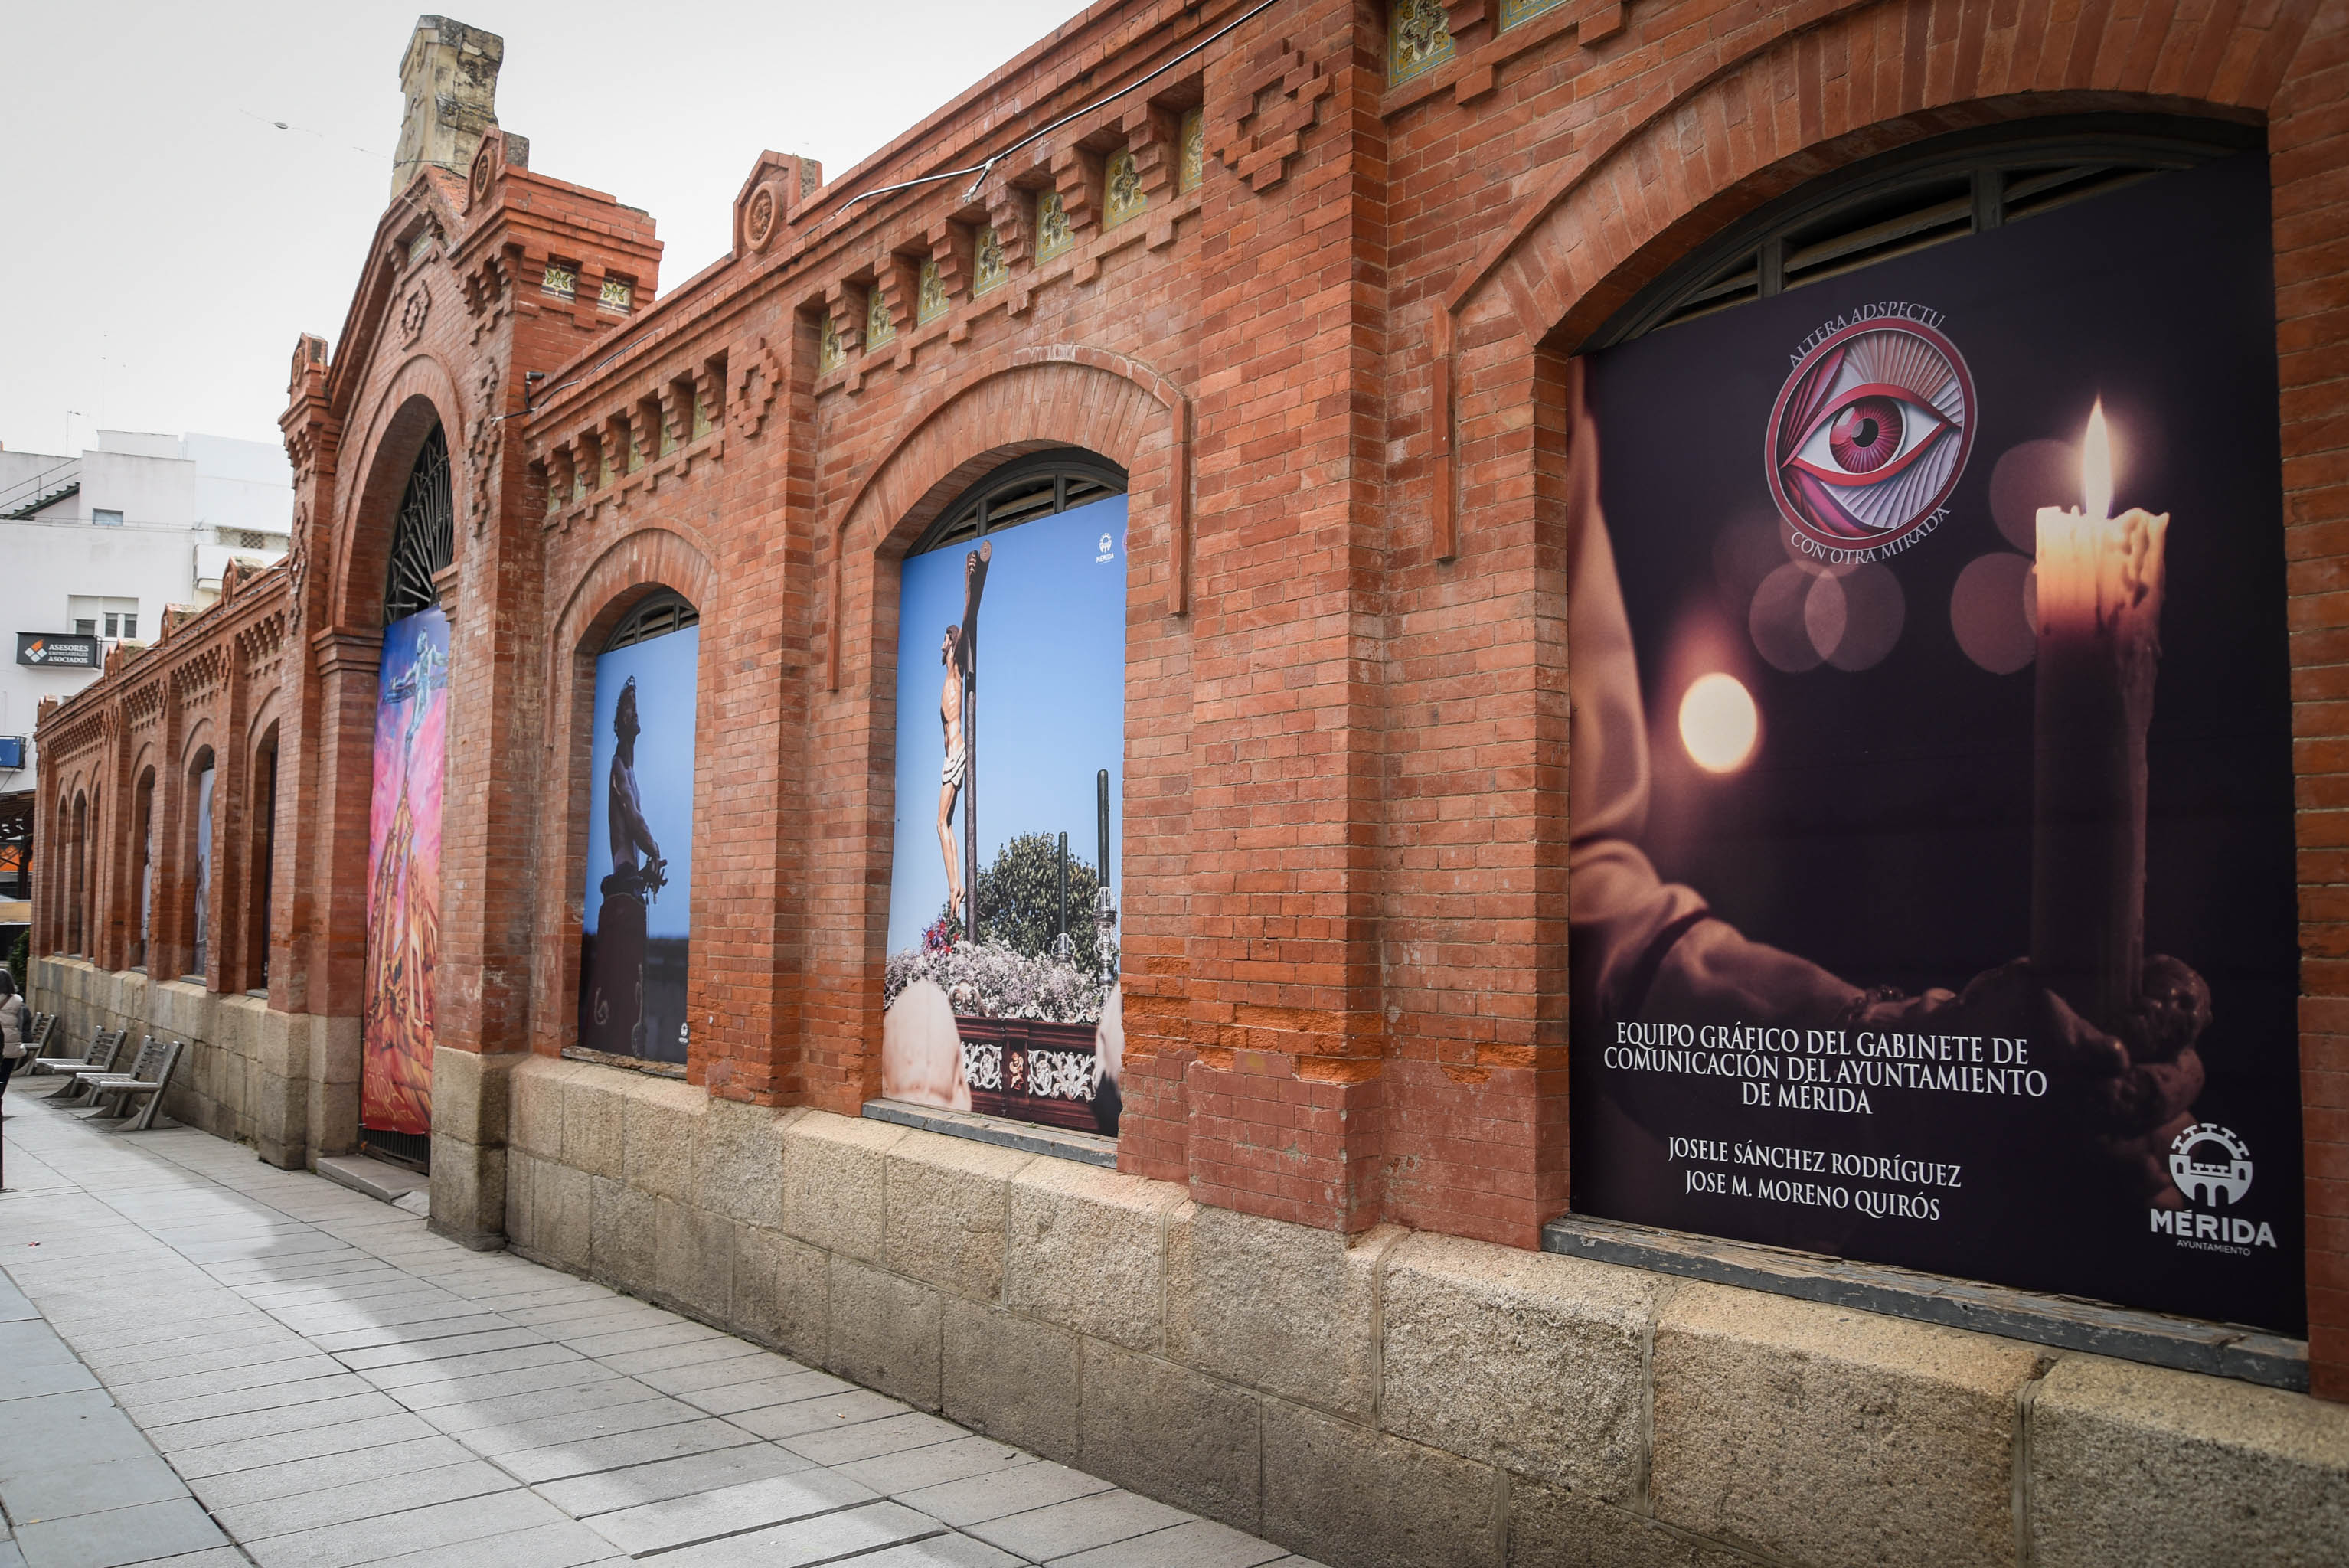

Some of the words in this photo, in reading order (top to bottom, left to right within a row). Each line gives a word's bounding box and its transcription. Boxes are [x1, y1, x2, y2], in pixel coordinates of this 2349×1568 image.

[1789, 315, 1847, 368] ALTERA
[1851, 301, 1946, 328] ADSPECTU
[1791, 531, 1826, 560] CON
[1830, 549, 1877, 565] OTRA
[1881, 507, 1951, 560] MIRADA
[1616, 1022, 1694, 1050] EQUIPO
[1700, 1021, 1799, 1053] GRÁFICO
[1806, 1030, 1851, 1056] DEL
[1857, 1031, 1984, 1063] GABINETE
[1991, 1037, 2029, 1065] DE
[1604, 1047, 1779, 1080] COMUNICACIÓN
[1786, 1057, 1831, 1083] DEL
[1835, 1060, 2047, 1097] AYUNTAMIENTO
[1742, 1081, 1771, 1106] DE
[1777, 1080, 1874, 1114] MÉRIDA
[1668, 1137, 1729, 1162] JOSELE
[1734, 1139, 1825, 1173] SÁNCHEZ
[1831, 1153, 1962, 1188] RODRÍGUEZ
[1684, 1170, 1726, 1195] JOSE
[1730, 1176, 1753, 1197] M.
[1757, 1178, 1849, 1209] MORENO
[1854, 1191, 1941, 1221] QUIRÓS
[2150, 1208, 2278, 1249] MÉRIDA
[2176, 1239, 2251, 1256] AYUNTAMIENTO
